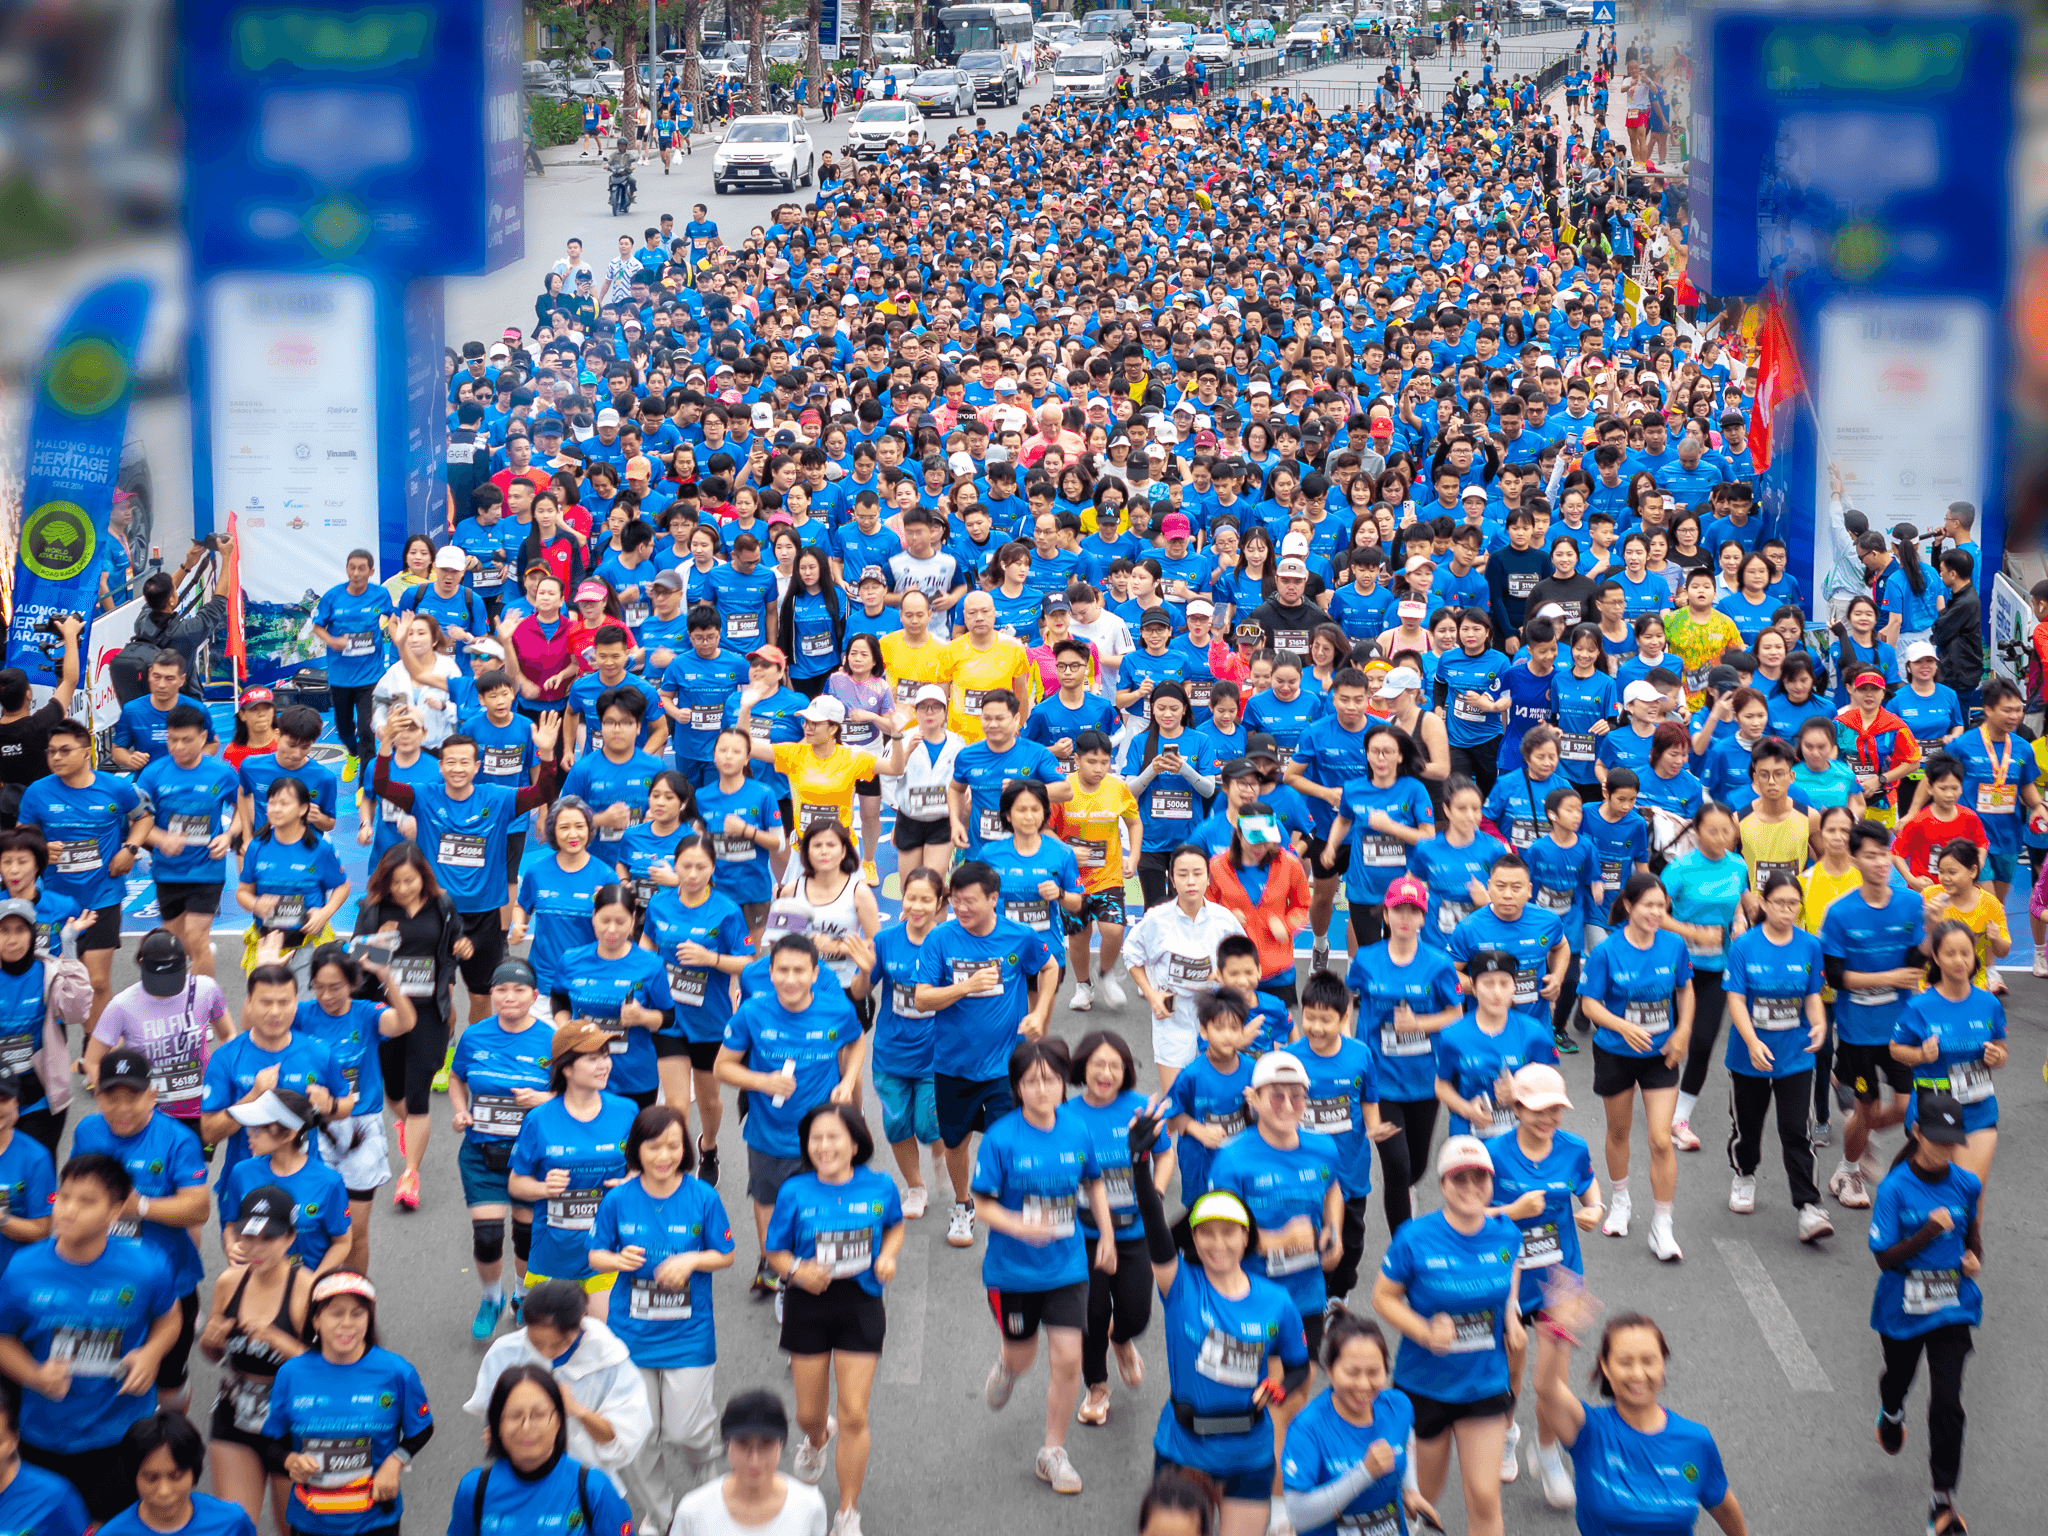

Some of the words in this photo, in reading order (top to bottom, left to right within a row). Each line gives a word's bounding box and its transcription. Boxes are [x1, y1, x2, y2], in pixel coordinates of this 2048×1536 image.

[326, 406, 358, 414] ReVive
[35, 438, 87, 454] HALONG
[88, 444, 112, 457] BAY
[326, 450, 357, 458] Vinamilk
[33, 451, 110, 473] HERITAGE
[30, 465, 108, 485] MARATHON
[38, 552, 73, 562] ATHLETICS
[44, 546, 69, 556] WORLD
[15, 603, 58, 616] ALONG
[1573, 743, 1592, 751] 53914
[1166, 800, 1189, 809] 50064
[1601, 872, 1618, 880] 9692
[142, 1010, 200, 1040] FULFILL
[142, 1038, 172, 1060] THE
[174, 1029, 203, 1054] LIFE
[171, 1074, 199, 1088] 56185
[569, 1203, 598, 1215] 51021
